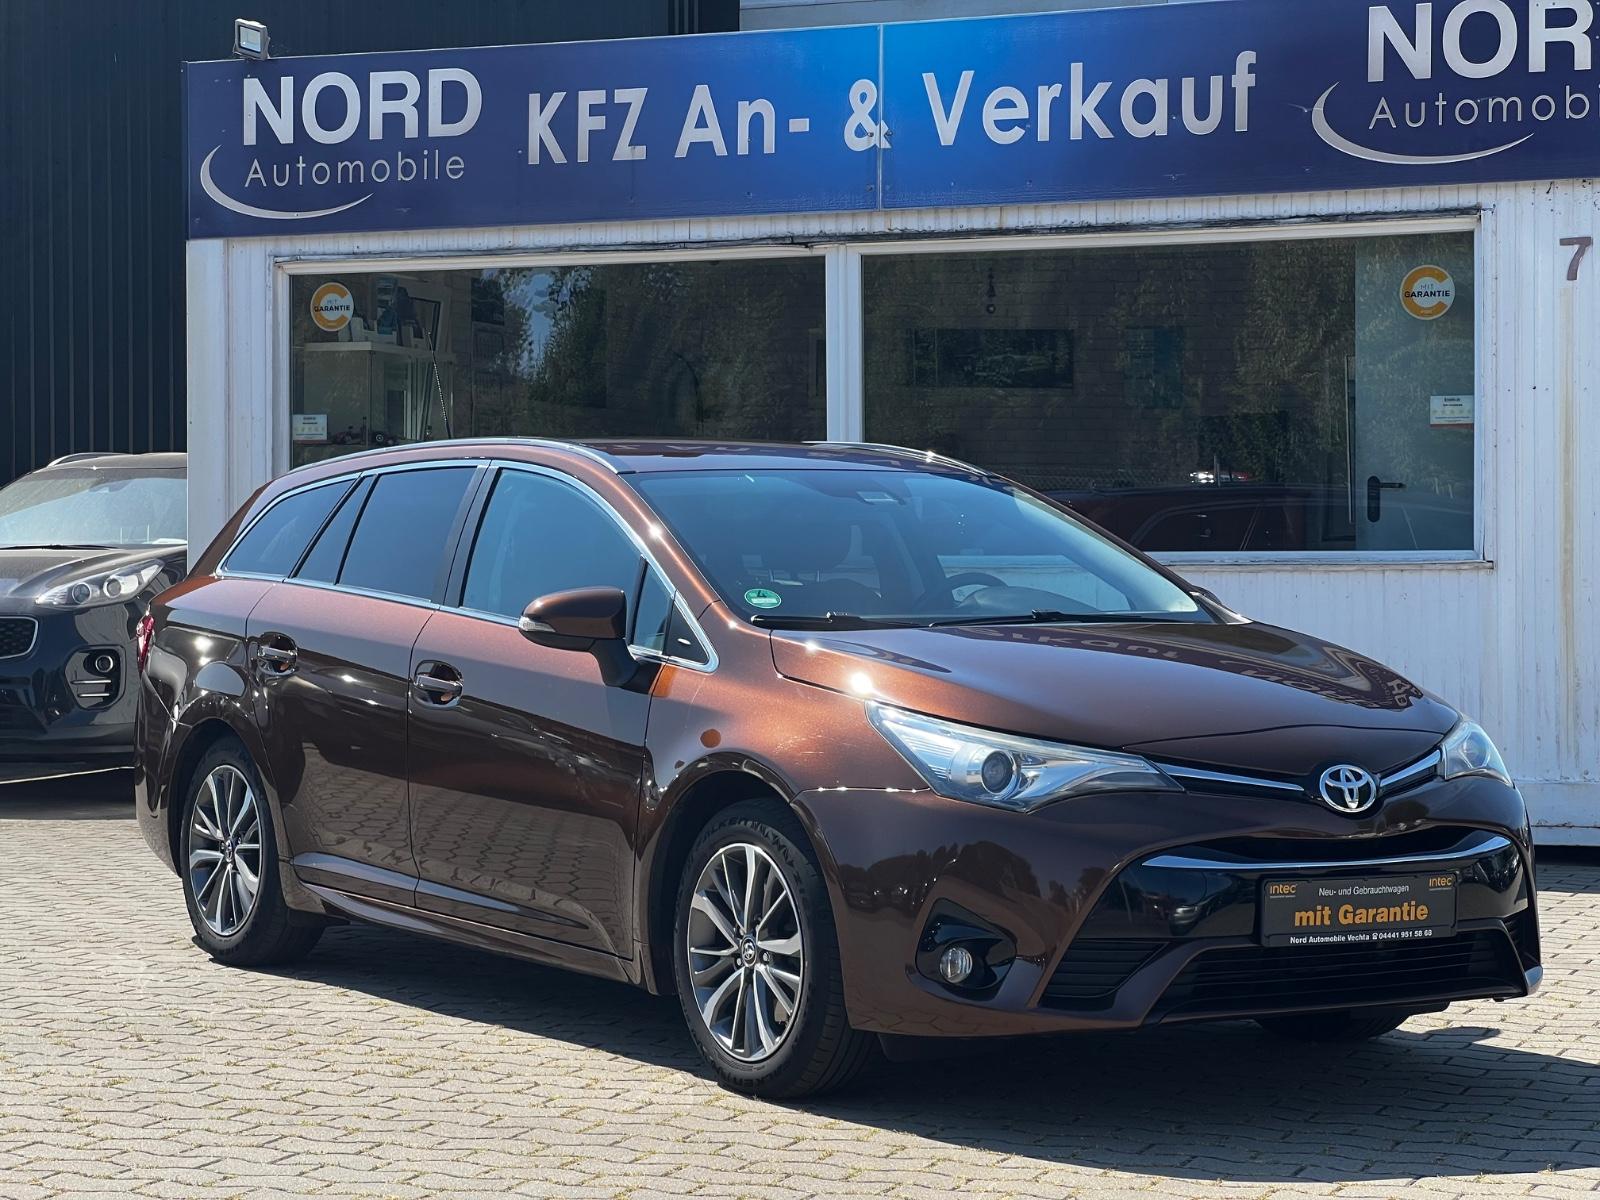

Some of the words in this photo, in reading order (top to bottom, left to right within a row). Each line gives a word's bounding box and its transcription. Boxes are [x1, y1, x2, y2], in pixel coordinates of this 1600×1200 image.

[243, 68, 482, 146] NORD
[528, 87, 648, 165] KFZ
[674, 84, 809, 158] An-
[843, 79, 891, 153] &
[922, 50, 1257, 147] Verkauf
[244, 150, 466, 188] Automobile
[1559, 237, 1593, 281] 7
[1405, 290, 1451, 298] GARANTIE
[313, 304, 351, 313] GARANTIE
[1429, 876, 1453, 887] intec
[1269, 883, 1297, 895] intec
[1318, 887, 1337, 897] Neu-
[1338, 885, 1352, 895] und
[1353, 884, 1410, 896] Gebrauchtwagen
[1294, 905, 1332, 927] mit
[1338, 899, 1429, 925] Garantie
[1290, 936, 1307, 944] Nord
[1308, 935, 1346, 943] Automobile
[1347, 933, 1370, 942] Vechta
